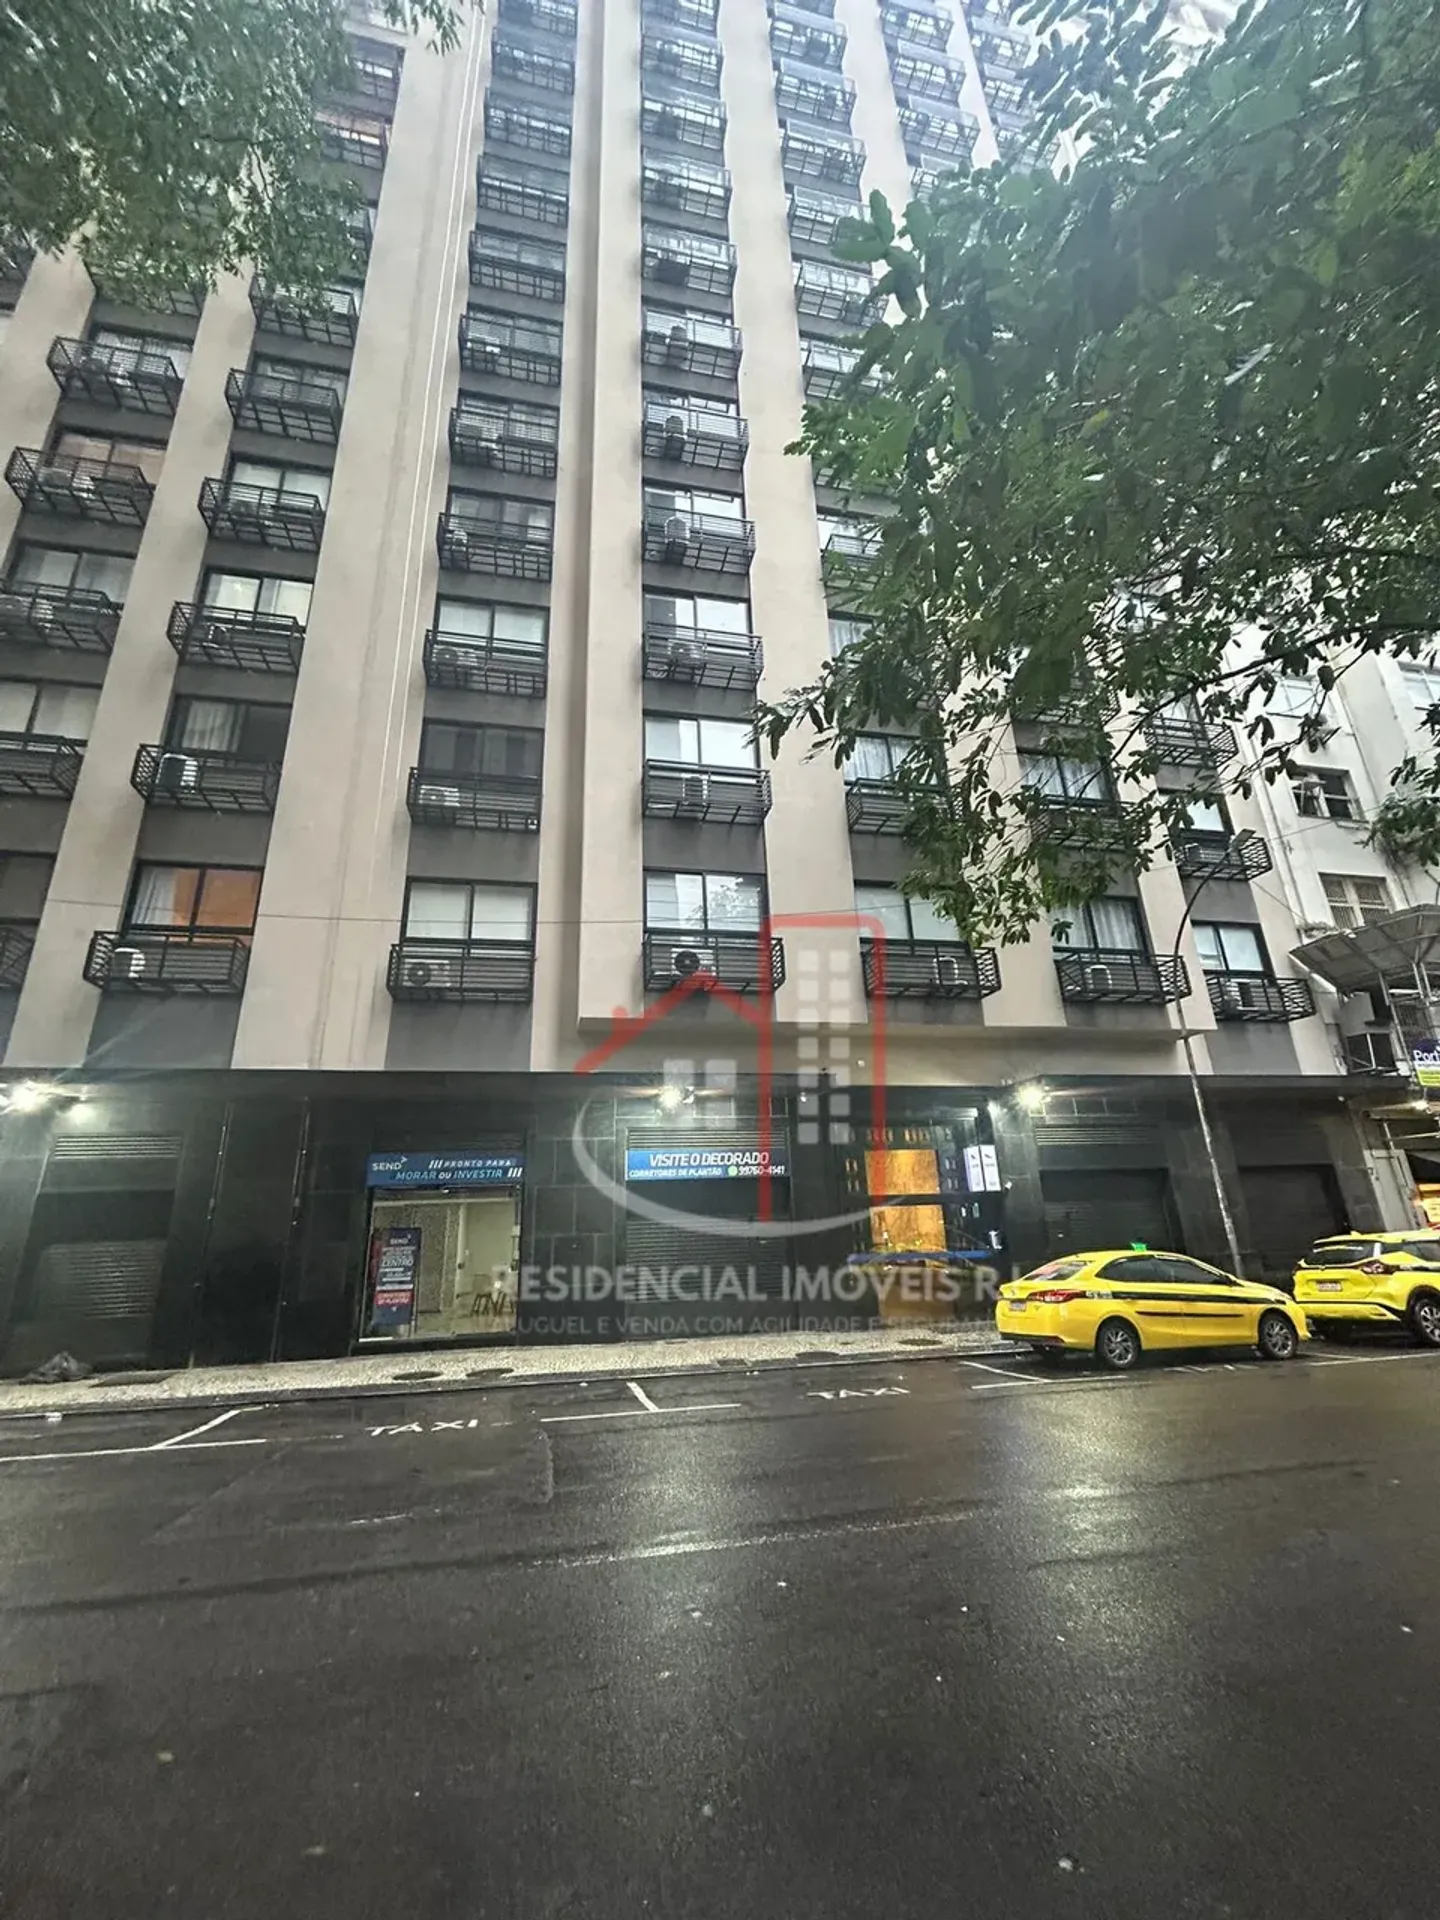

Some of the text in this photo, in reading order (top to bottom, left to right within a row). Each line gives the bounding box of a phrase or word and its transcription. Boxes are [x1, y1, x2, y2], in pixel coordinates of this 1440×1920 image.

[372, 1161, 402, 1171] SEND
[443, 1159, 512, 1169] PRONTO PARA
[649, 1152, 770, 1167] VISITE O DECORADO
[395, 1170, 437, 1180] MORAR
[453, 1168, 503, 1179] INVESTIR
[805, 1386, 911, 1400] TAXI
[364, 1418, 479, 1437] TAXI
